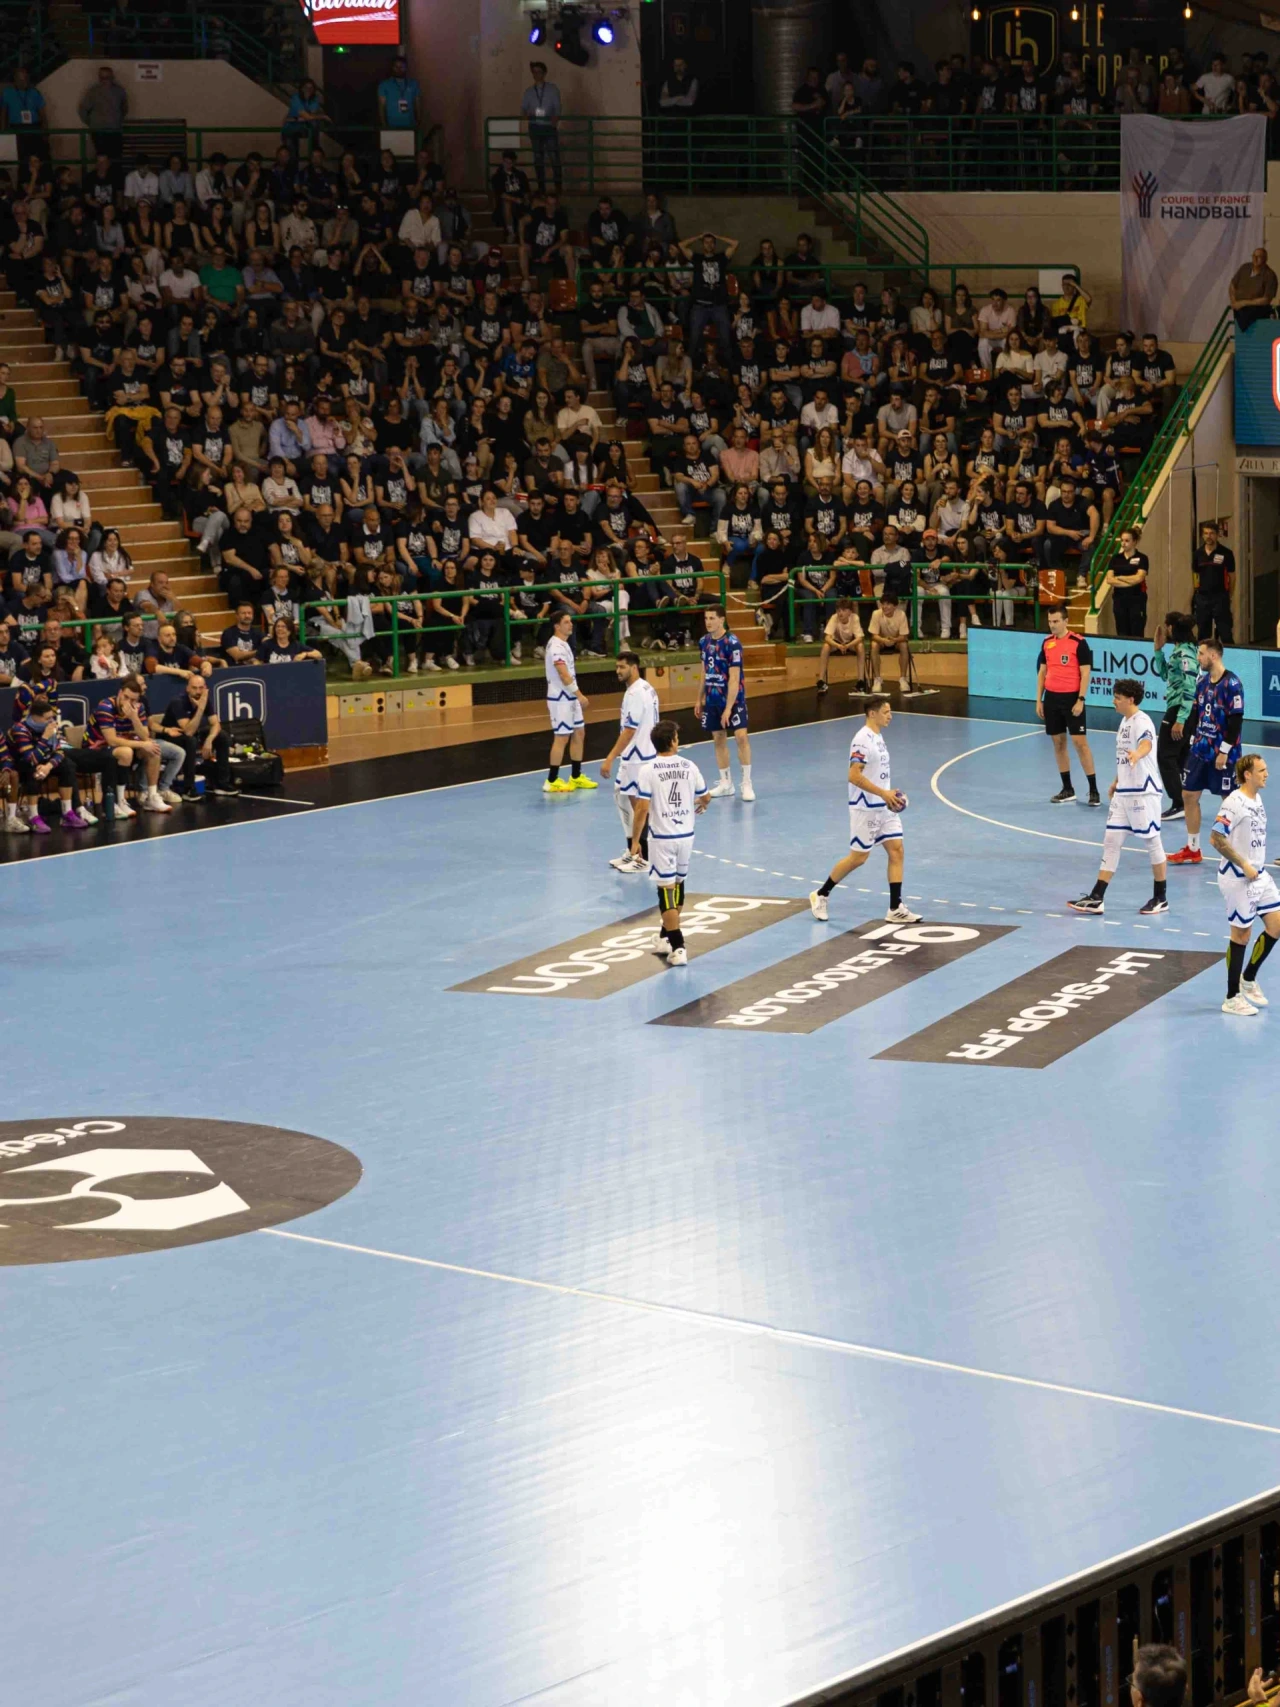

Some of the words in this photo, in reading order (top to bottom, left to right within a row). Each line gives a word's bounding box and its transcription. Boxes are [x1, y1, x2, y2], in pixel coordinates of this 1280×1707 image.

[1161, 195, 1195, 205] COUPE
[1198, 196, 1212, 205] DE
[708, 656, 715, 668] 3
[1090, 677, 1112, 686] ARTS
[1090, 686, 1100, 695] ET
[1205, 703, 1212, 717] 9
[668, 781, 682, 808] 4
[714, 943, 921, 1026] FLEXOCOLOR
[946, 951, 1165, 1060] LH-SHOP.FR
